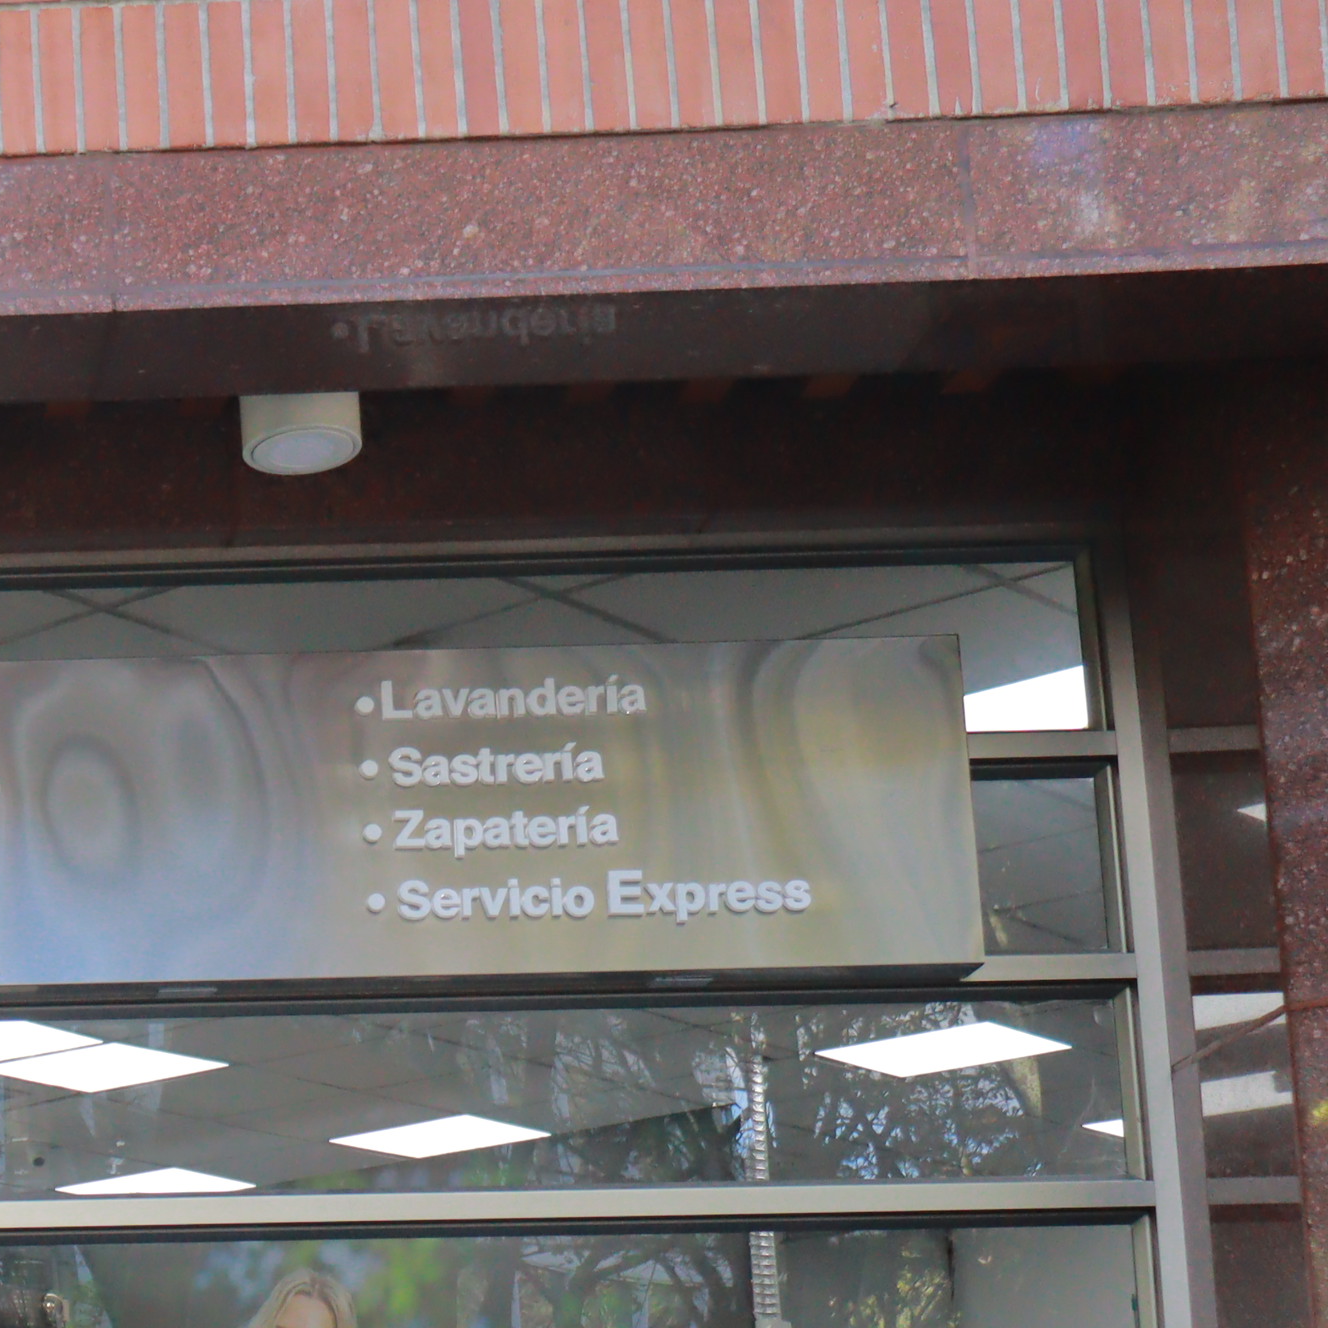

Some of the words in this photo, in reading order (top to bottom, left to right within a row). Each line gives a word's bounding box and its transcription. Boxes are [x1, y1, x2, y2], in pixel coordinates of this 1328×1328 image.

[381, 674, 646, 720] Lavandería
[388, 742, 605, 787] Sastrería
[393, 805, 619, 858] Zapatería
[397, 876, 595, 922] Servicio
[607, 869, 812, 924] Express
